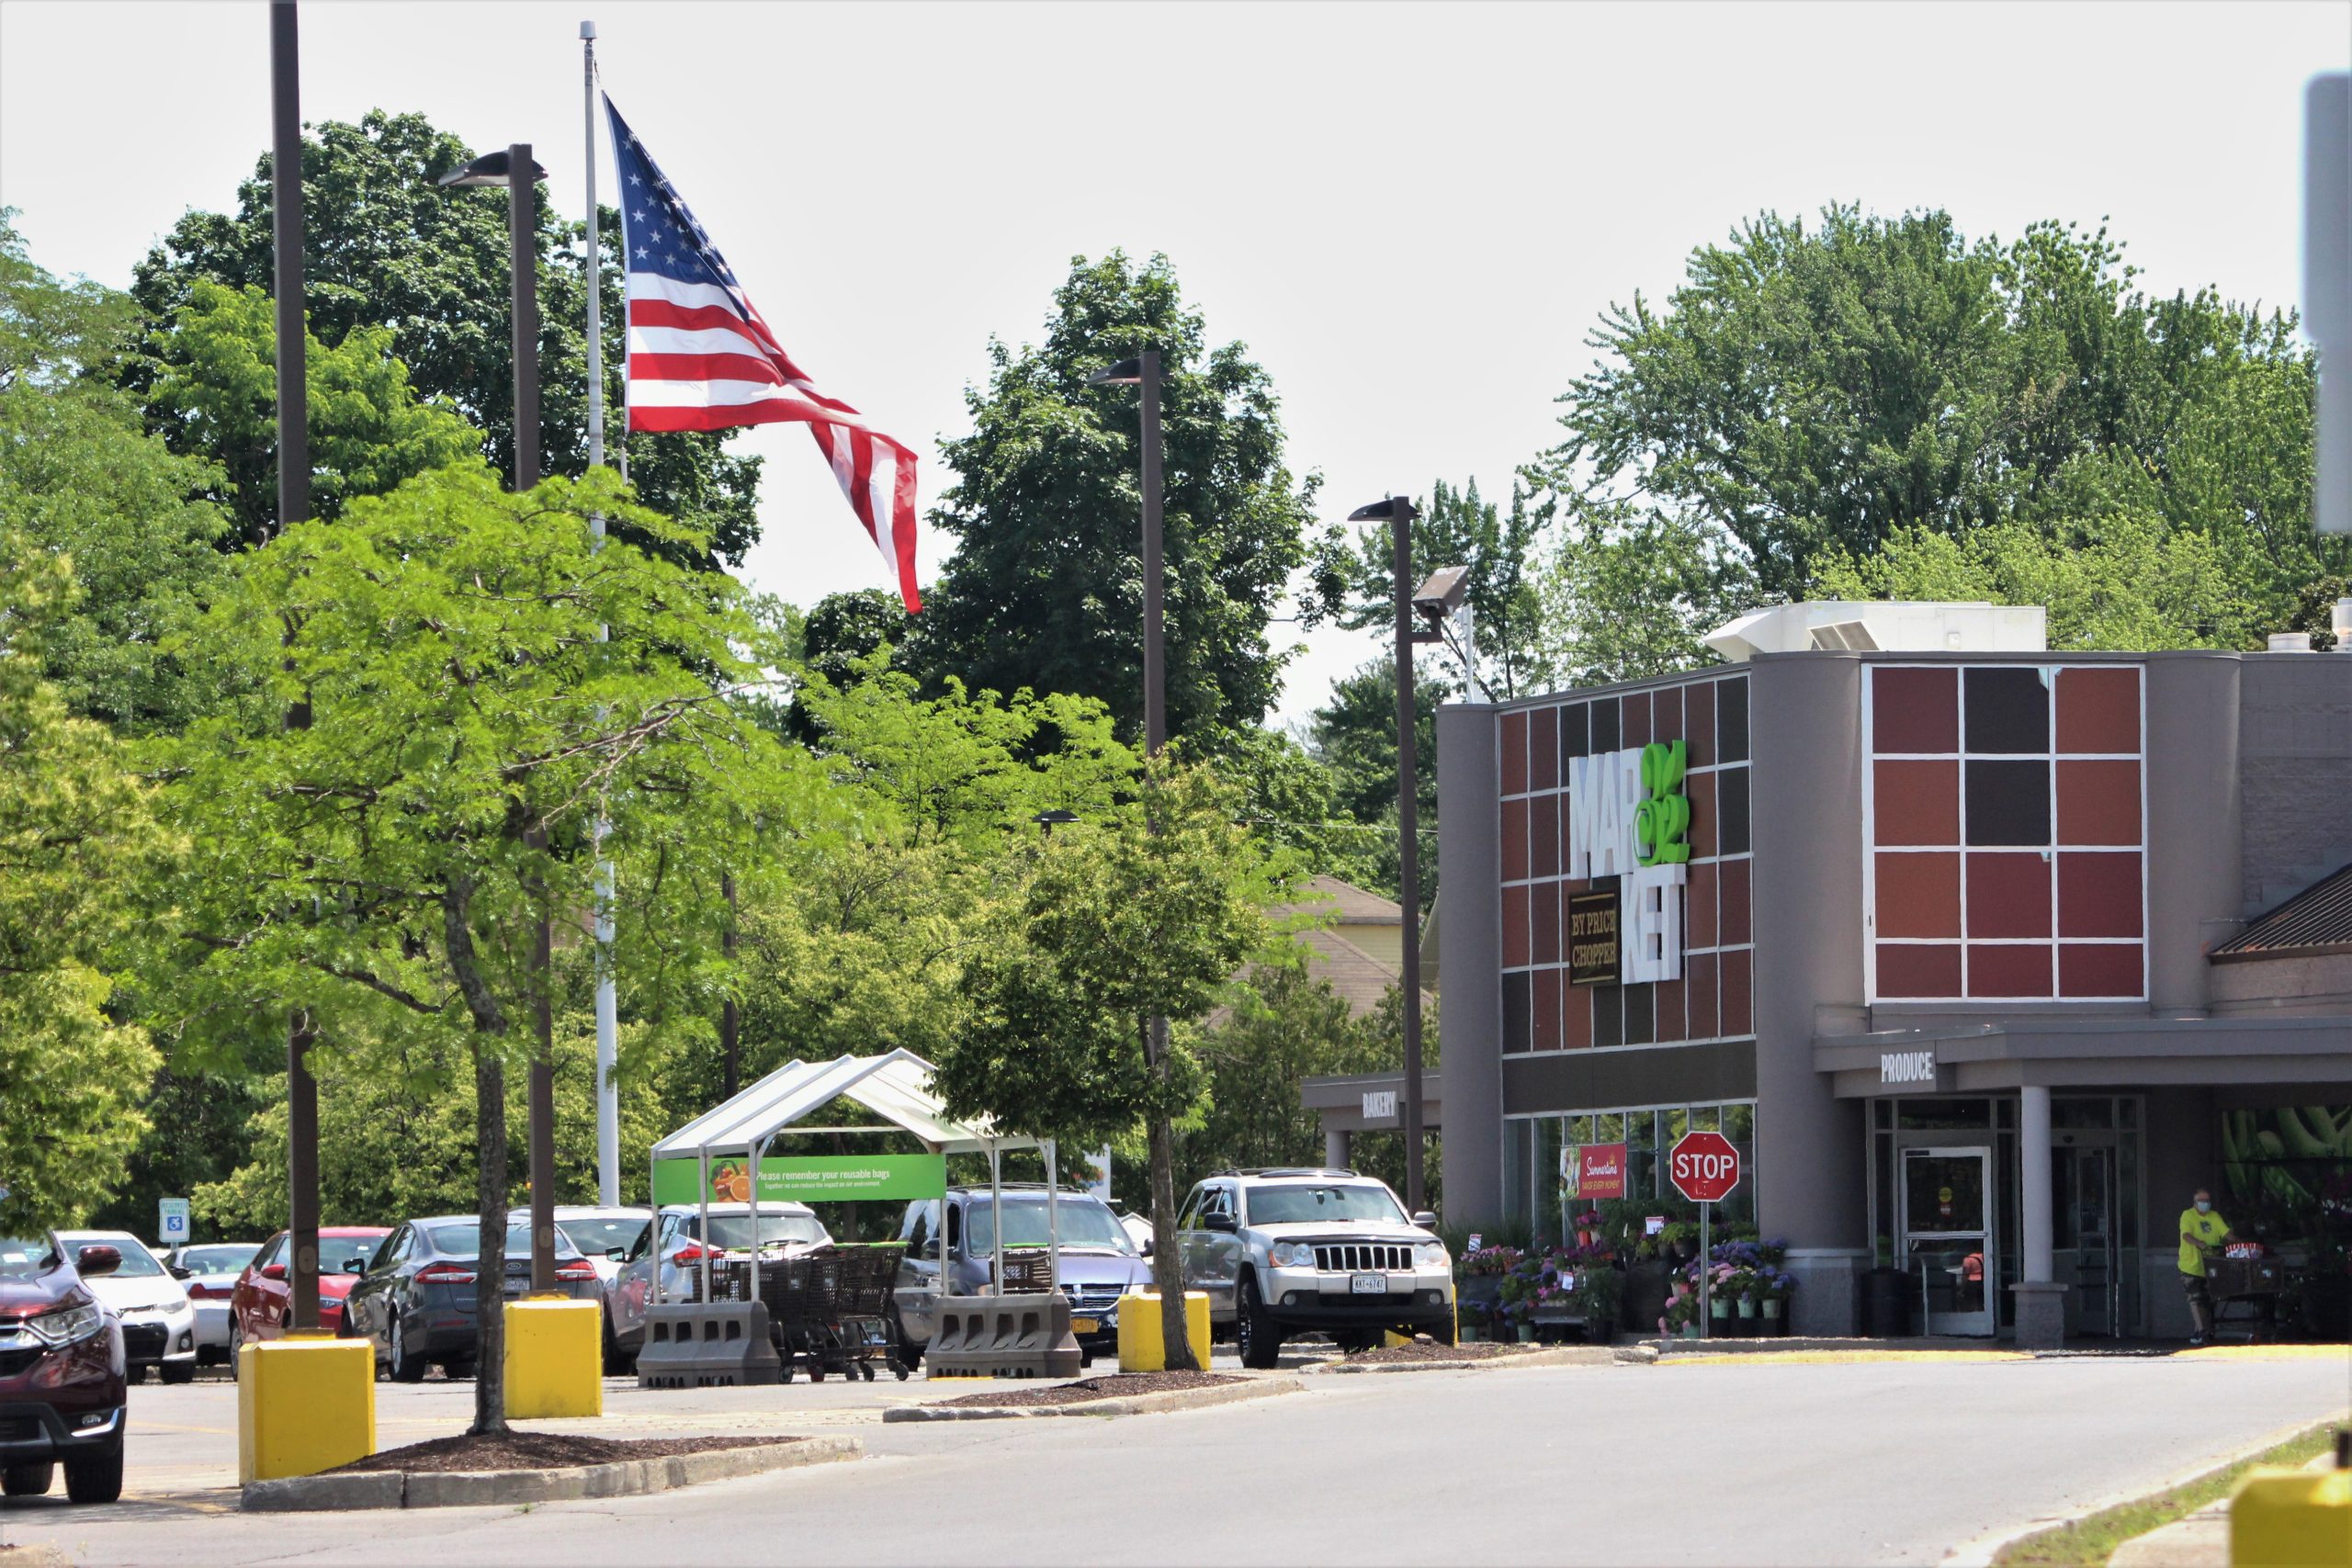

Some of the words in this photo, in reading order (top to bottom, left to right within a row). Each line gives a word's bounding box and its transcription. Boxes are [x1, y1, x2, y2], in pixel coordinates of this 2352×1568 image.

[1571, 913, 1585, 936] BY
[1587, 909, 1616, 935] PRICE
[1572, 942, 1616, 968] CHOPPER
[1881, 1051, 1934, 1083] PRODUCE
[1363, 1090, 1396, 1119] BAKERY
[756, 1171, 781, 1181] Please
[782, 1169, 820, 1180] remember
[821, 1171, 839, 1182] your
[840, 1168, 871, 1179] reusable
[872, 1168, 890, 1180] bags
[1675, 1153, 1735, 1179] STOP
